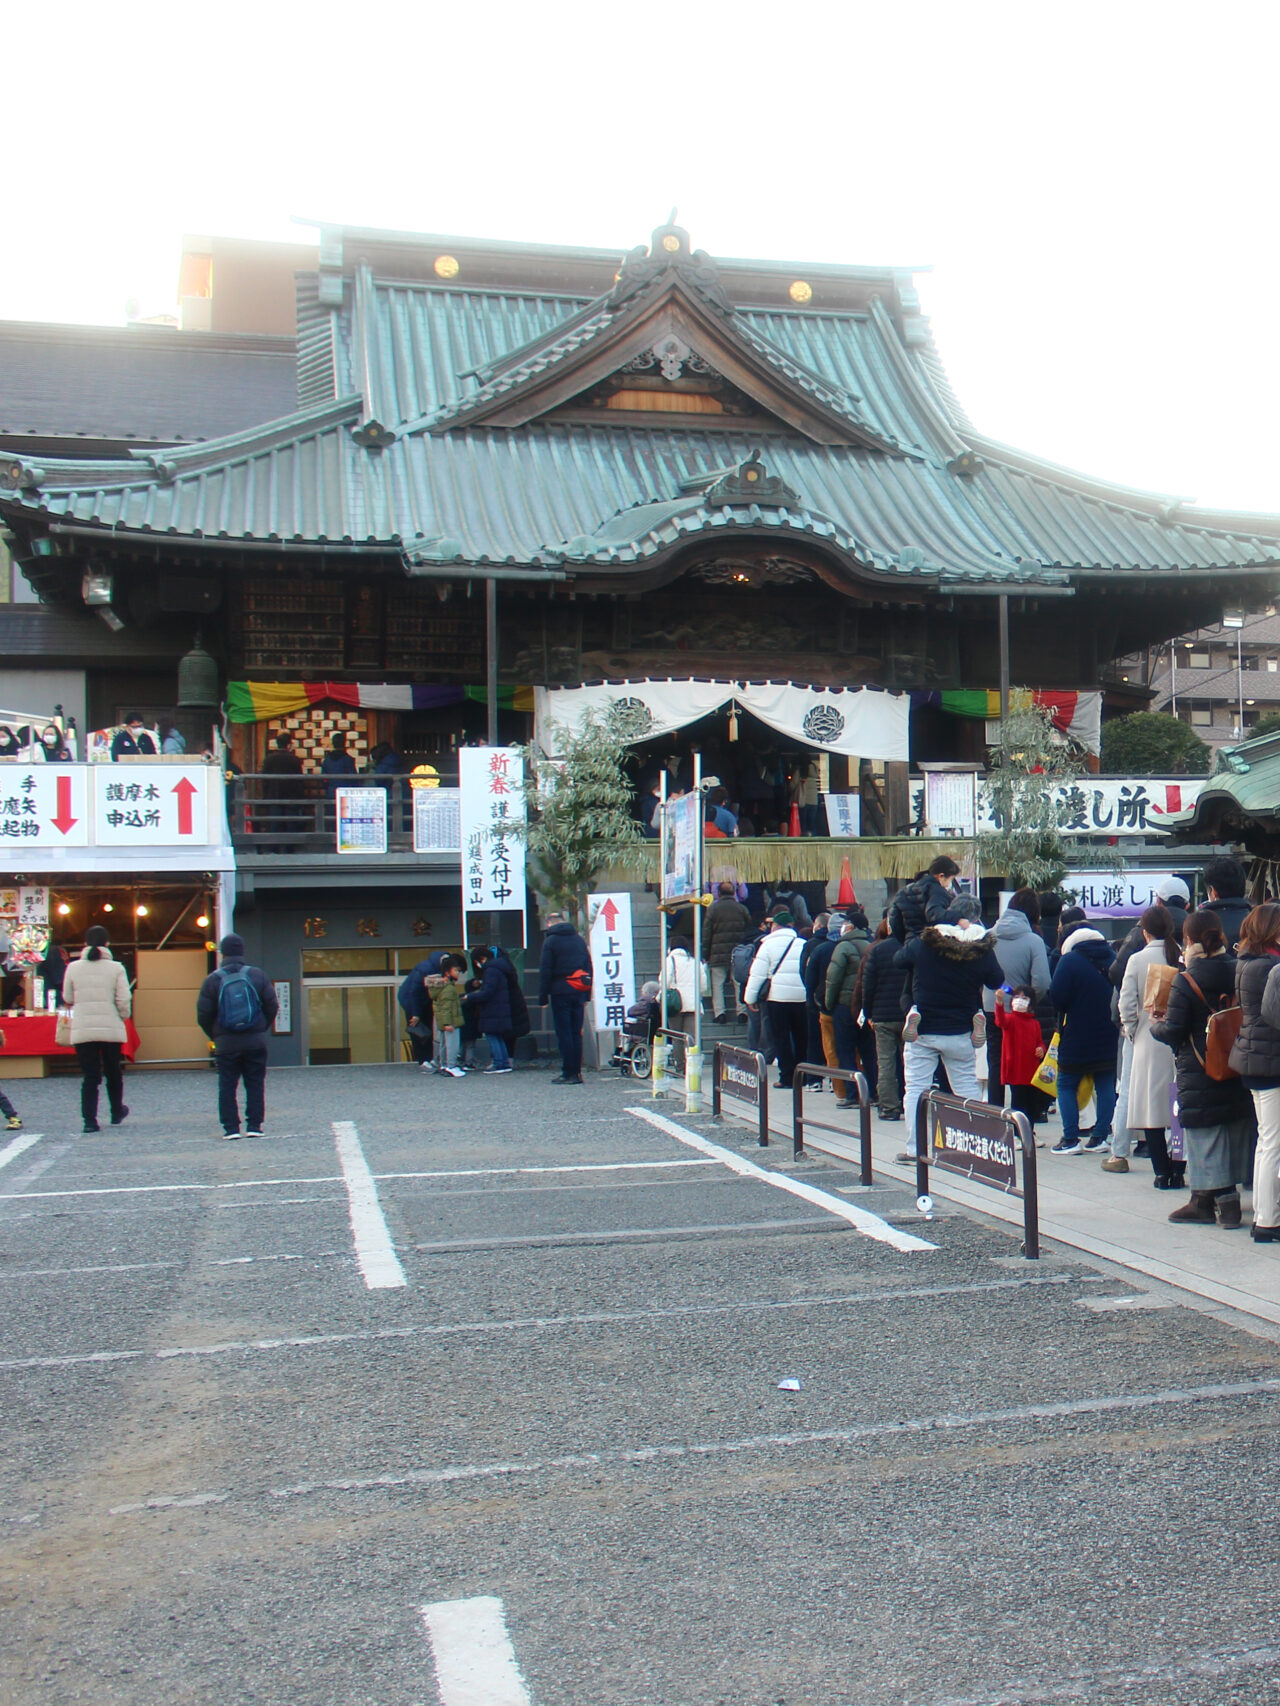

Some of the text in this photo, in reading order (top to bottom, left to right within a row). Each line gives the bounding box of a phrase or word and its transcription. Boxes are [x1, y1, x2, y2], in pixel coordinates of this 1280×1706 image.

[489, 753, 511, 795] 新春
[106, 783, 161, 801] 護摩木
[0, 796, 37, 815] 魔矢
[0, 819, 41, 837] 起物
[106, 809, 161, 828] 申込所
[600, 936, 627, 1027] 上り専用
[945, 1126, 1014, 1166] 通り抜けご注意ください
